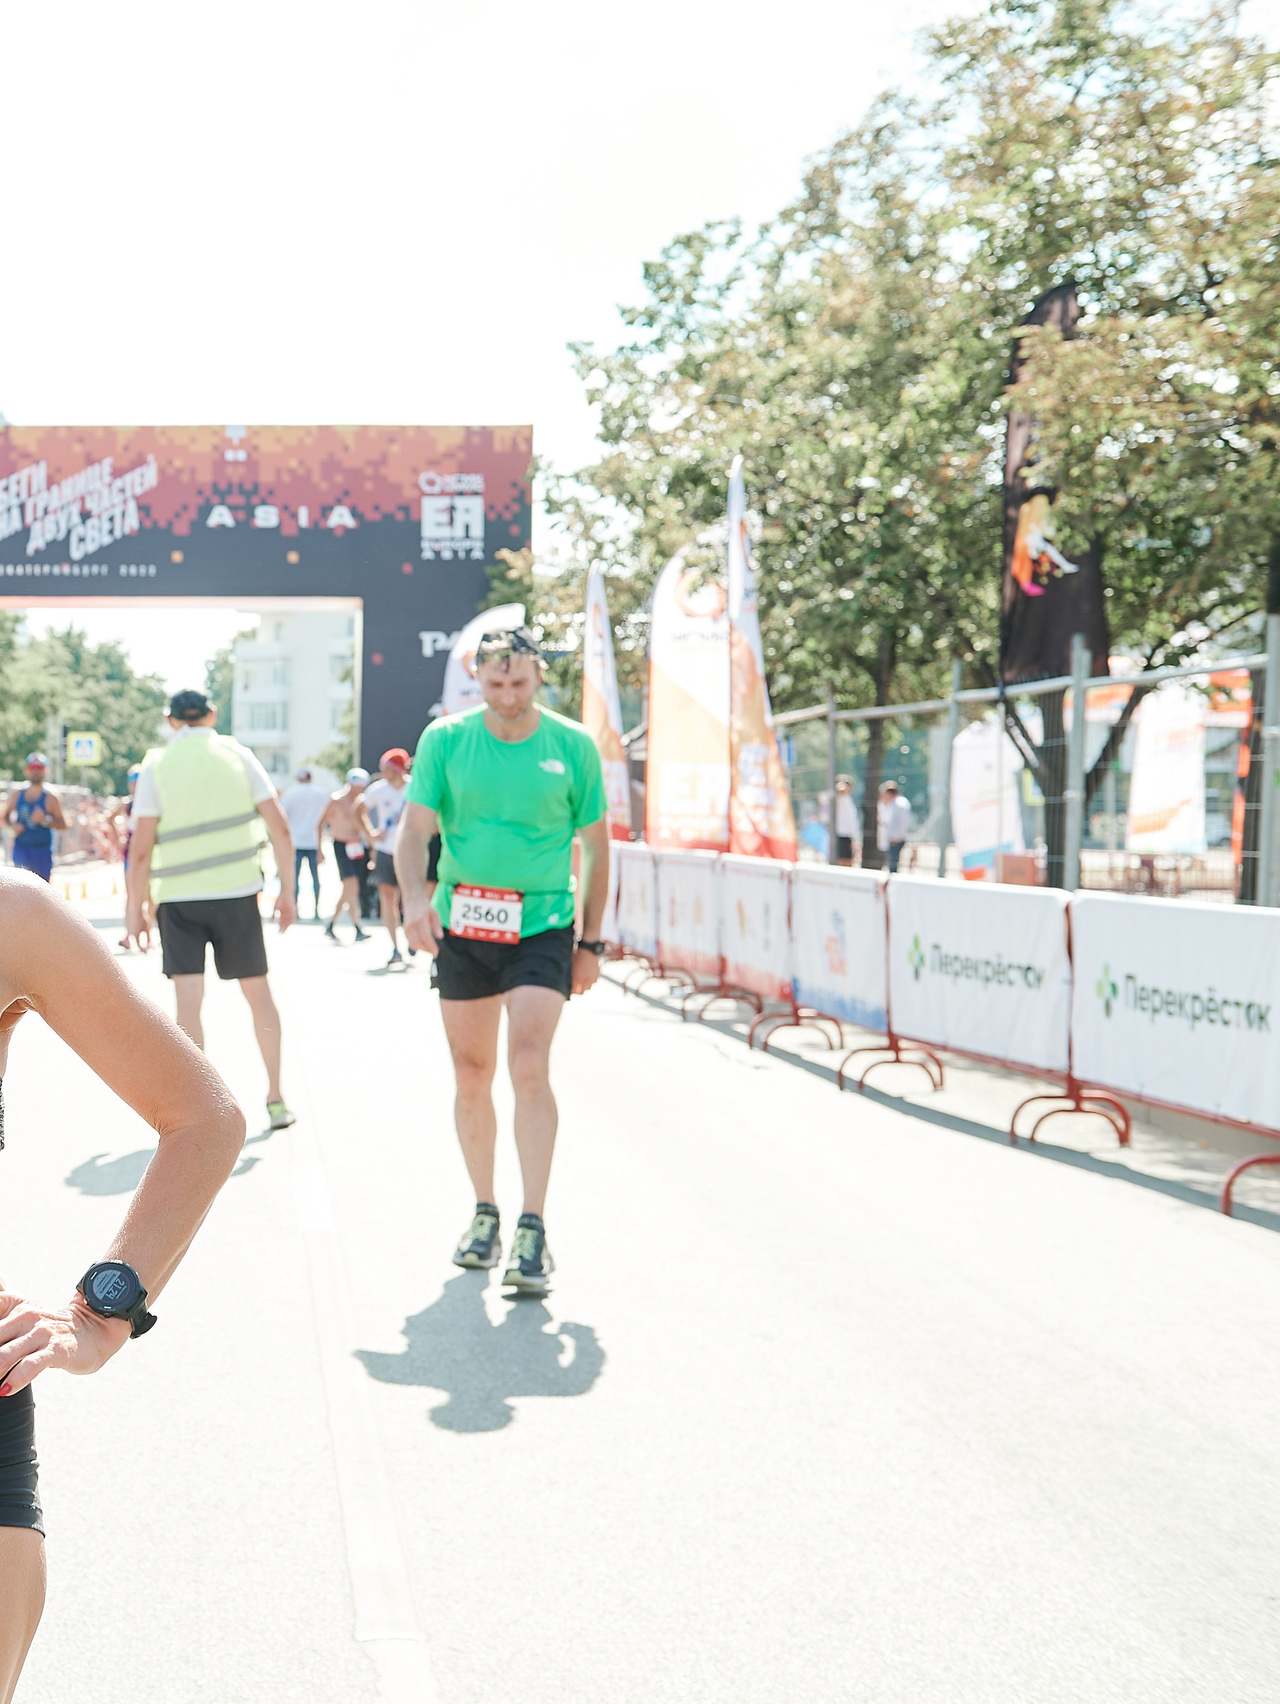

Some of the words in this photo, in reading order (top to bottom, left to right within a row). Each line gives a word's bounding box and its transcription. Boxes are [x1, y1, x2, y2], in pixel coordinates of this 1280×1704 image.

[205, 505, 357, 528] ASIA
[462, 904, 508, 924] 2560
[930, 944, 1045, 989] Перекрёсток
[1124, 974, 1271, 1031] Перекрёсток
